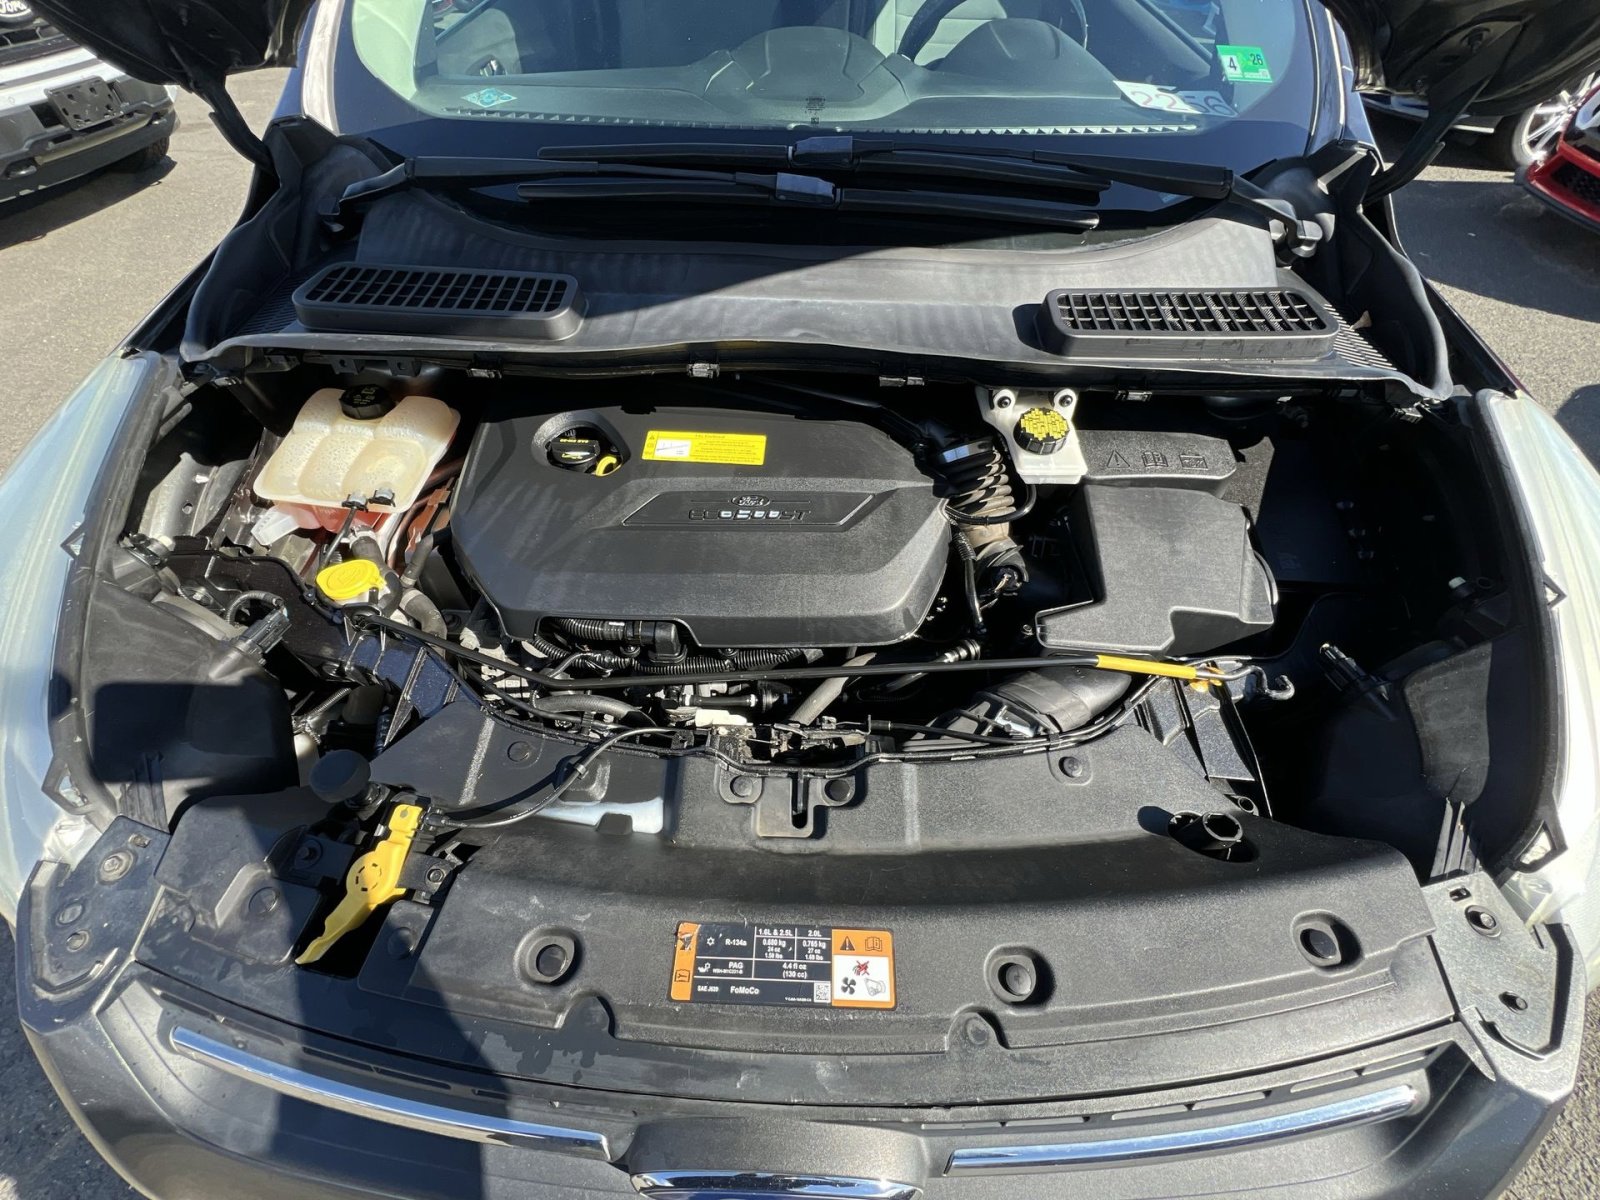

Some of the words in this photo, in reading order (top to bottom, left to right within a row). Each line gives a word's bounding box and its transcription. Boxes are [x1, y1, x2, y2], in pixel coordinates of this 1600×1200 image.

[1227, 57, 1237, 71] 4
[1250, 53, 1264, 66] 26
[725, 938, 747, 946] R-134a
[778, 939, 786, 948] kg
[818, 941, 826, 949] kg
[730, 986, 760, 995] FoMoCo
